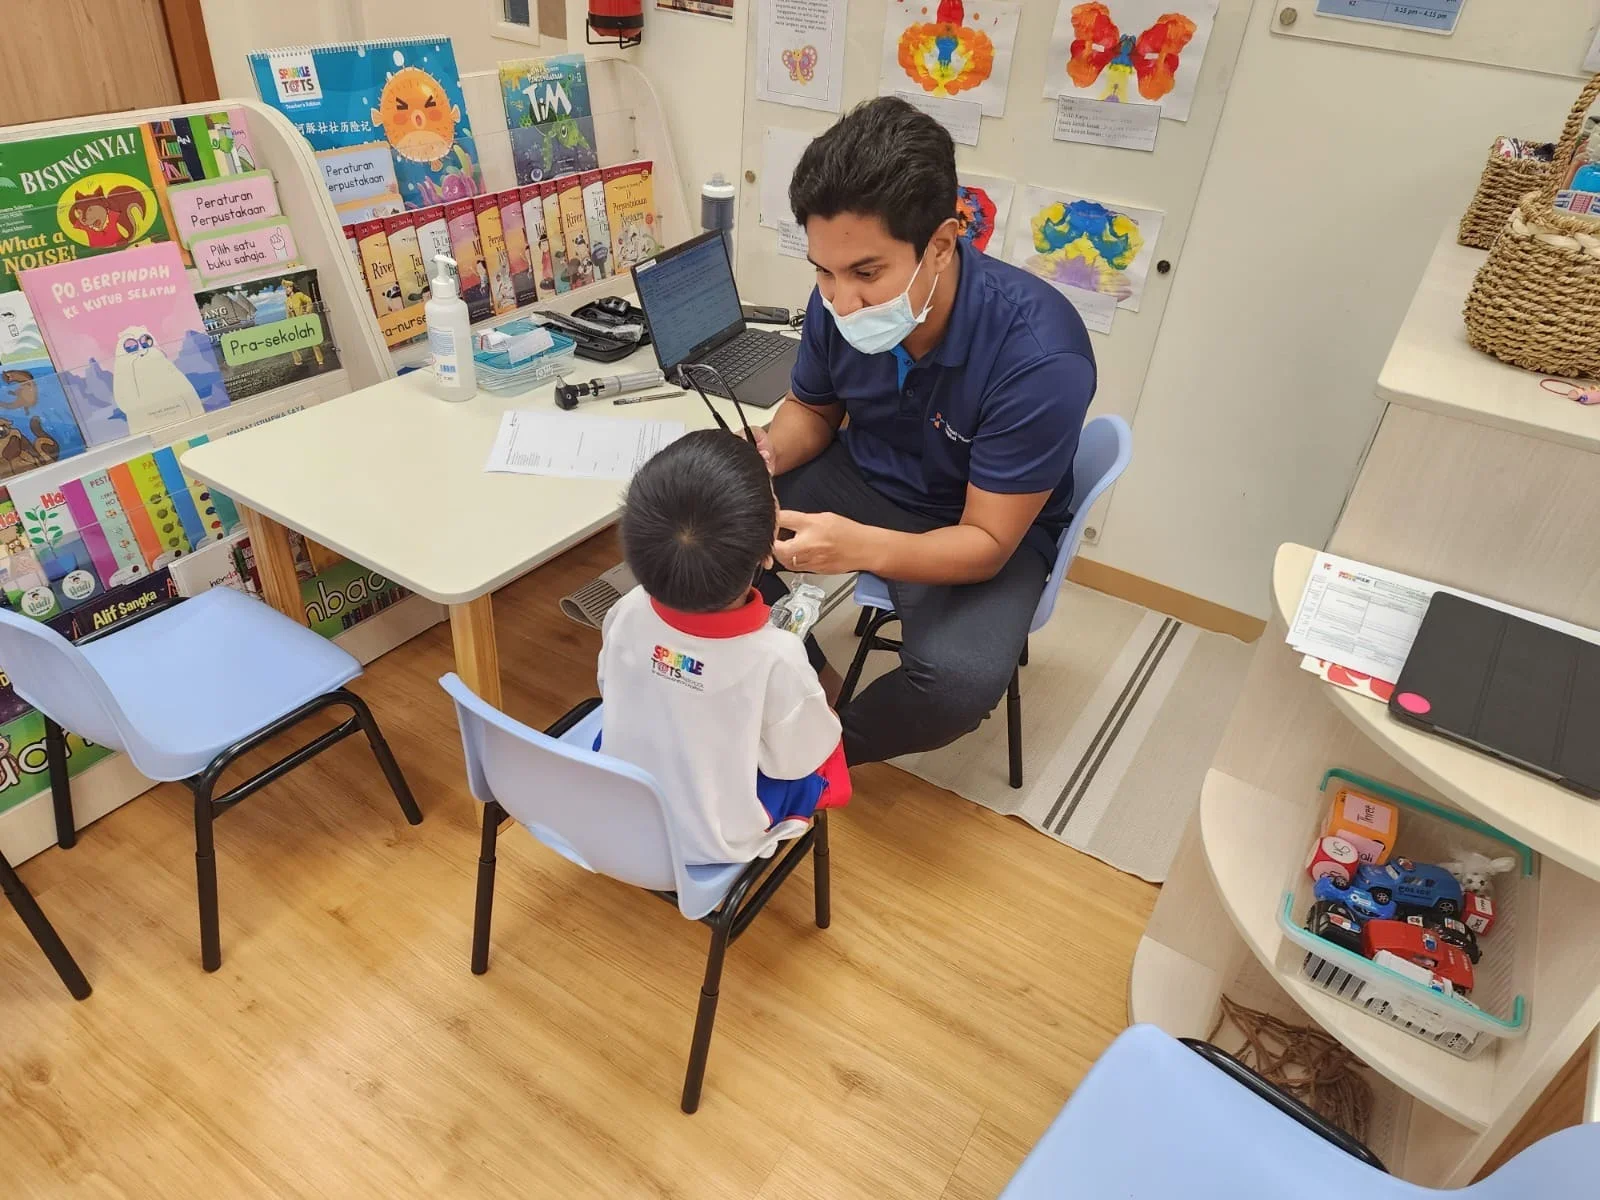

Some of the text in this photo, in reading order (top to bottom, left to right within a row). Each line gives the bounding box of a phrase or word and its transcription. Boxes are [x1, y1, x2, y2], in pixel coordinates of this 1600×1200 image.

[19, 133, 137, 195] BISINGNYA!
[326, 161, 374, 177] Peraturan
[327, 174, 385, 193] erpustakaan
[196, 191, 253, 210] Peraturan
[191, 205, 266, 227] Perpustakaan
[0, 231, 66, 255] What a
[210, 239, 256, 257] Pilih satu
[2, 245, 78, 274] NOISE!
[206, 250, 267, 272] buku sahaja.
[81, 265, 170, 293] BERPINDAH
[83, 293, 122, 311] KUTUB
[128, 285, 176, 300] SELATAN
[230, 322, 315, 355] Pra-sekolah
[93, 590, 158, 630] Alif Sangka
